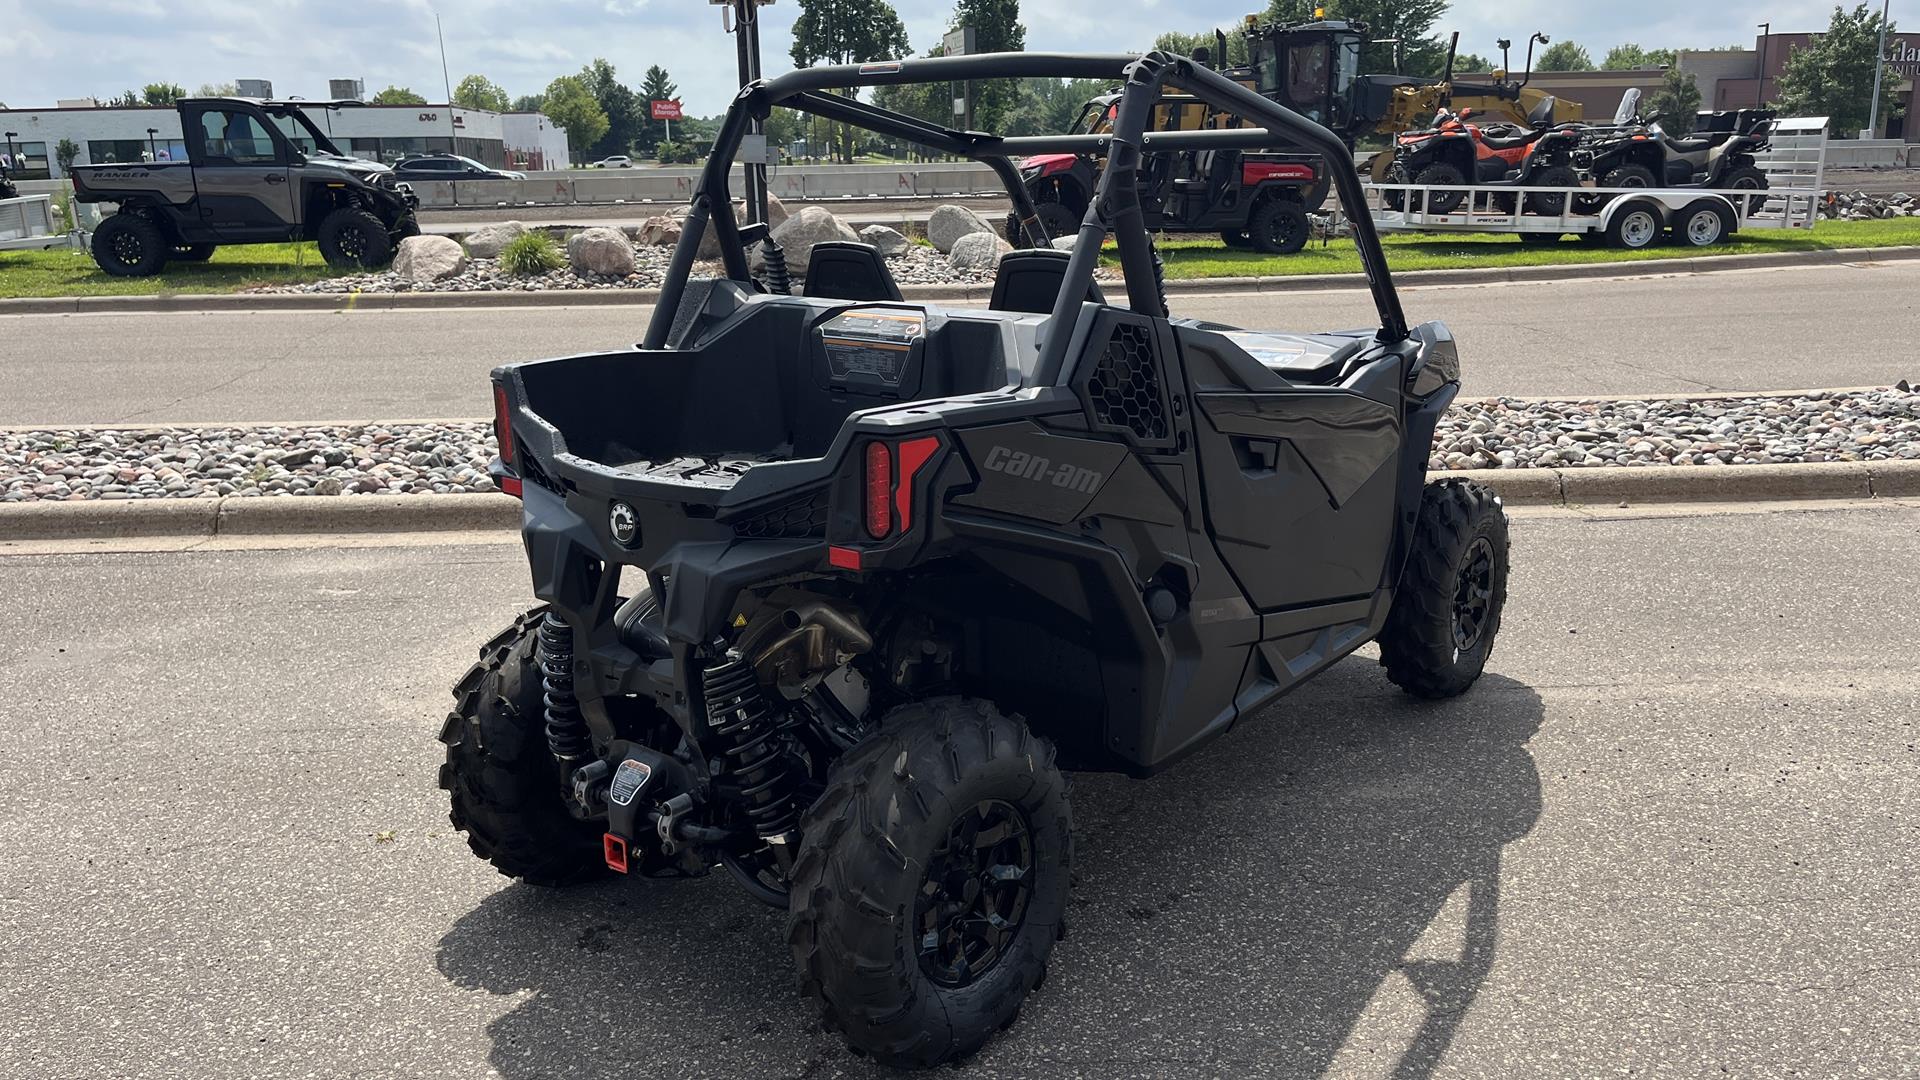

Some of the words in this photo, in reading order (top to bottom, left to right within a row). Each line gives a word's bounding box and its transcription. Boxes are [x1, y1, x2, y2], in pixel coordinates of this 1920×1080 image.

[655, 109, 679, 117] Storage
[418, 113, 437, 122] 6760
[899, 173, 910, 188] A
[618, 523, 634, 531] BRP
